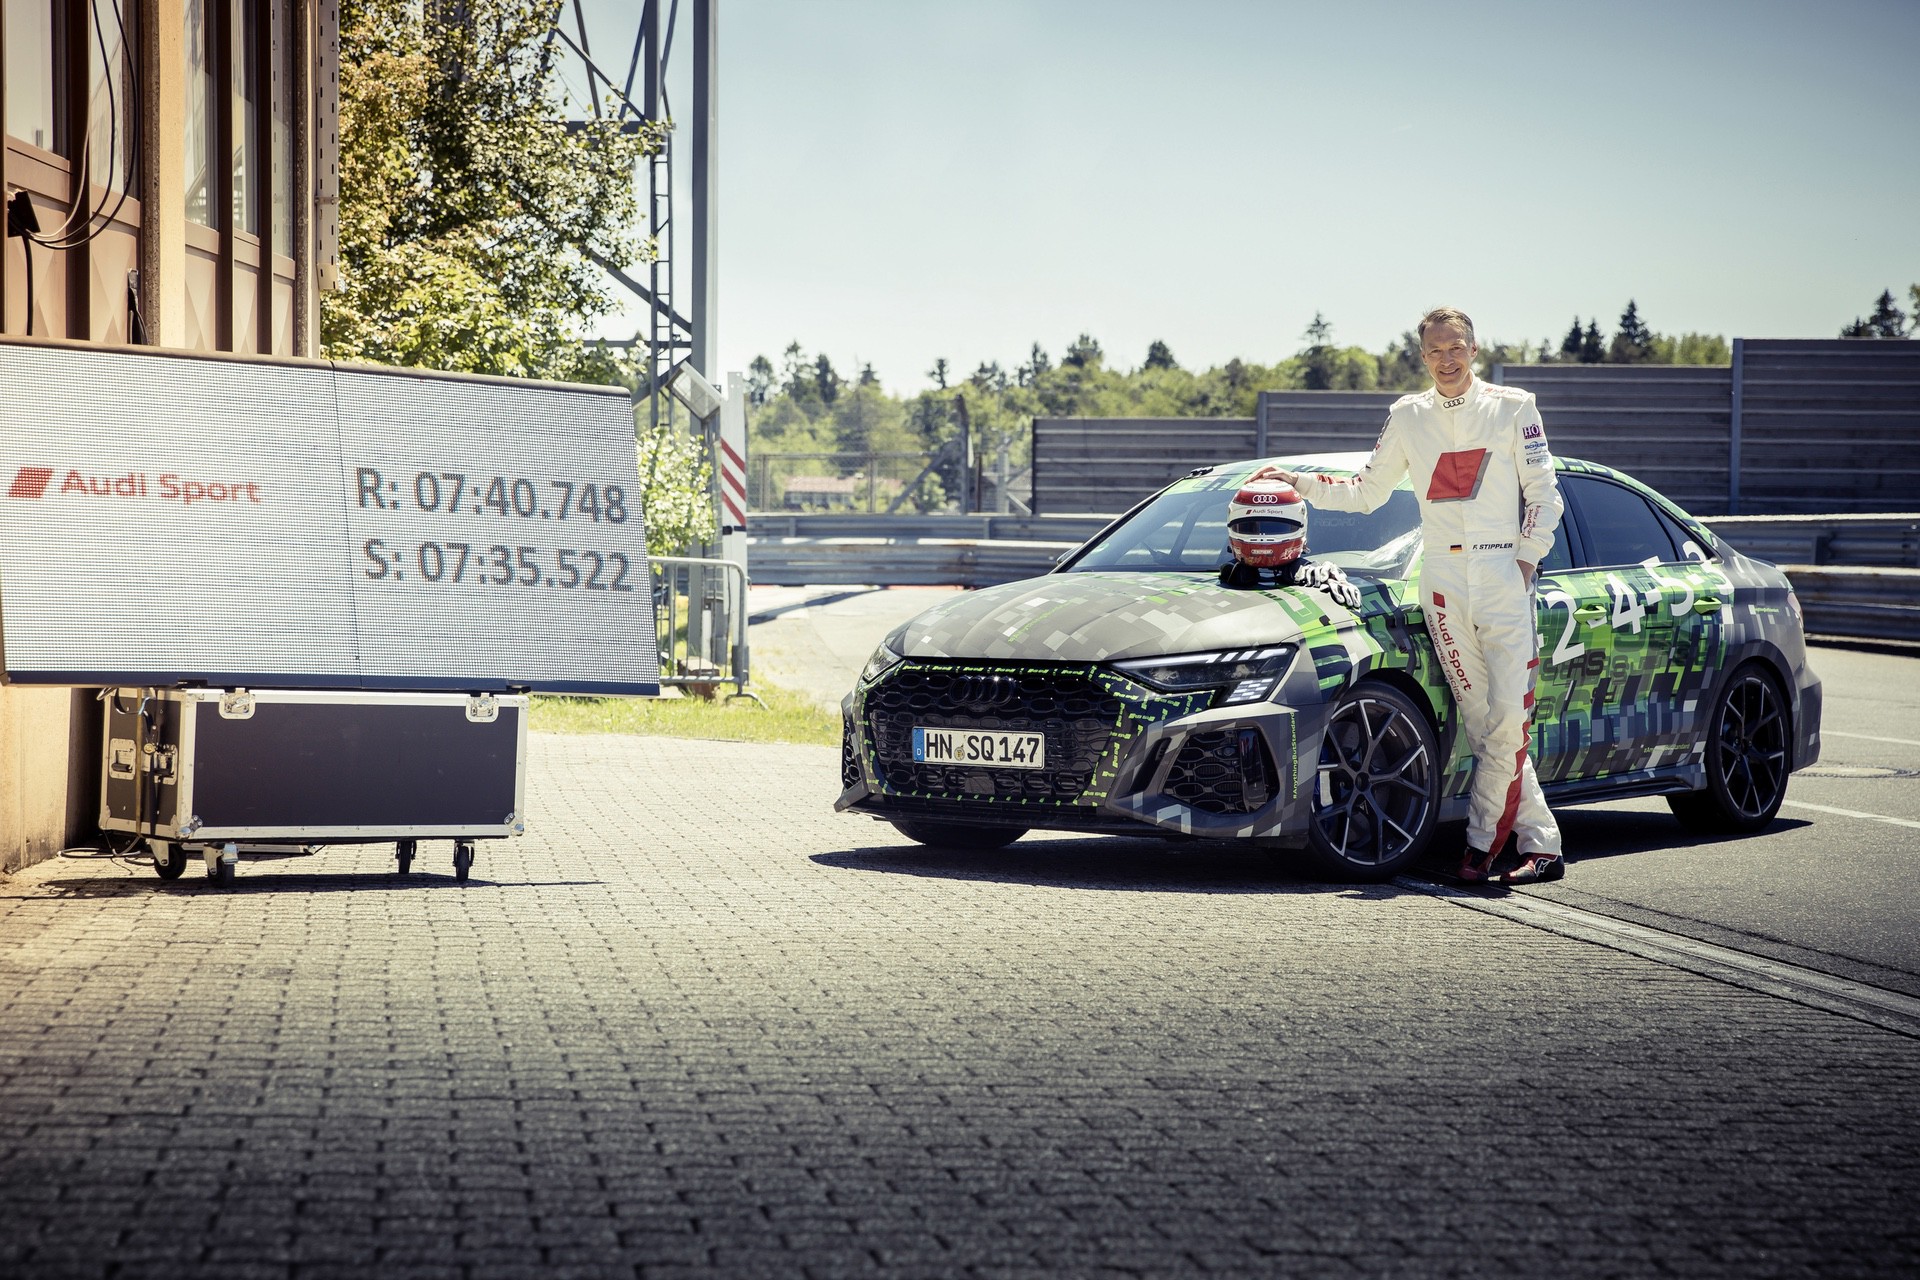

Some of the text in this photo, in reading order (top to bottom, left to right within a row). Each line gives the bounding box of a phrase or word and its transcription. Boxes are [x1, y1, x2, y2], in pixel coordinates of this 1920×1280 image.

[60, 469, 261, 505] Audi Sport
[356, 466, 628, 525] R: 07:40.748
[364, 538, 634, 593] S: 07:35.522
[1479, 542, 1514, 550] STIPPLER
[1427, 614, 1463, 702] customer racing
[1436, 611, 1472, 691] Audi Sport
[926, 733, 1040, 763] HN SQ 147
[1290, 711, 1298, 800] #AnythingButStandard
